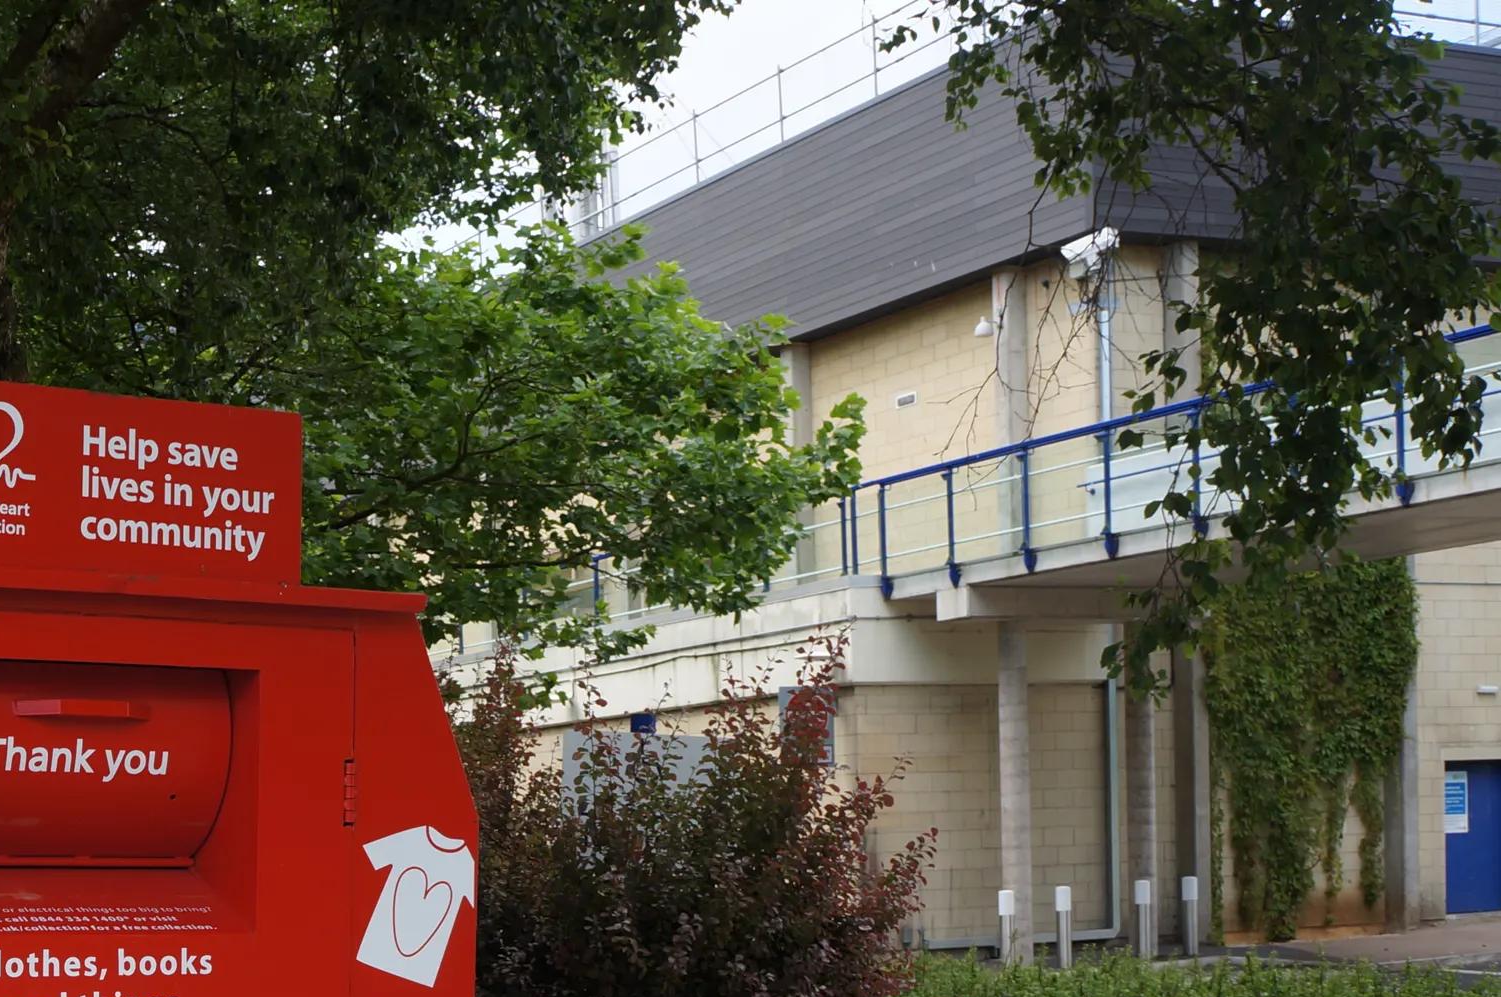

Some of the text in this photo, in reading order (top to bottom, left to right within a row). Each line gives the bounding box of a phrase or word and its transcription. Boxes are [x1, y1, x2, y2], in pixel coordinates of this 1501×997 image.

[83, 425, 237, 470] Help save
[82, 465, 274, 517] lives in your
[81, 517, 265, 561] community
[103, 750, 168, 782] you
[76, 906, 114, 914] things
[118, 948, 212, 976] books
